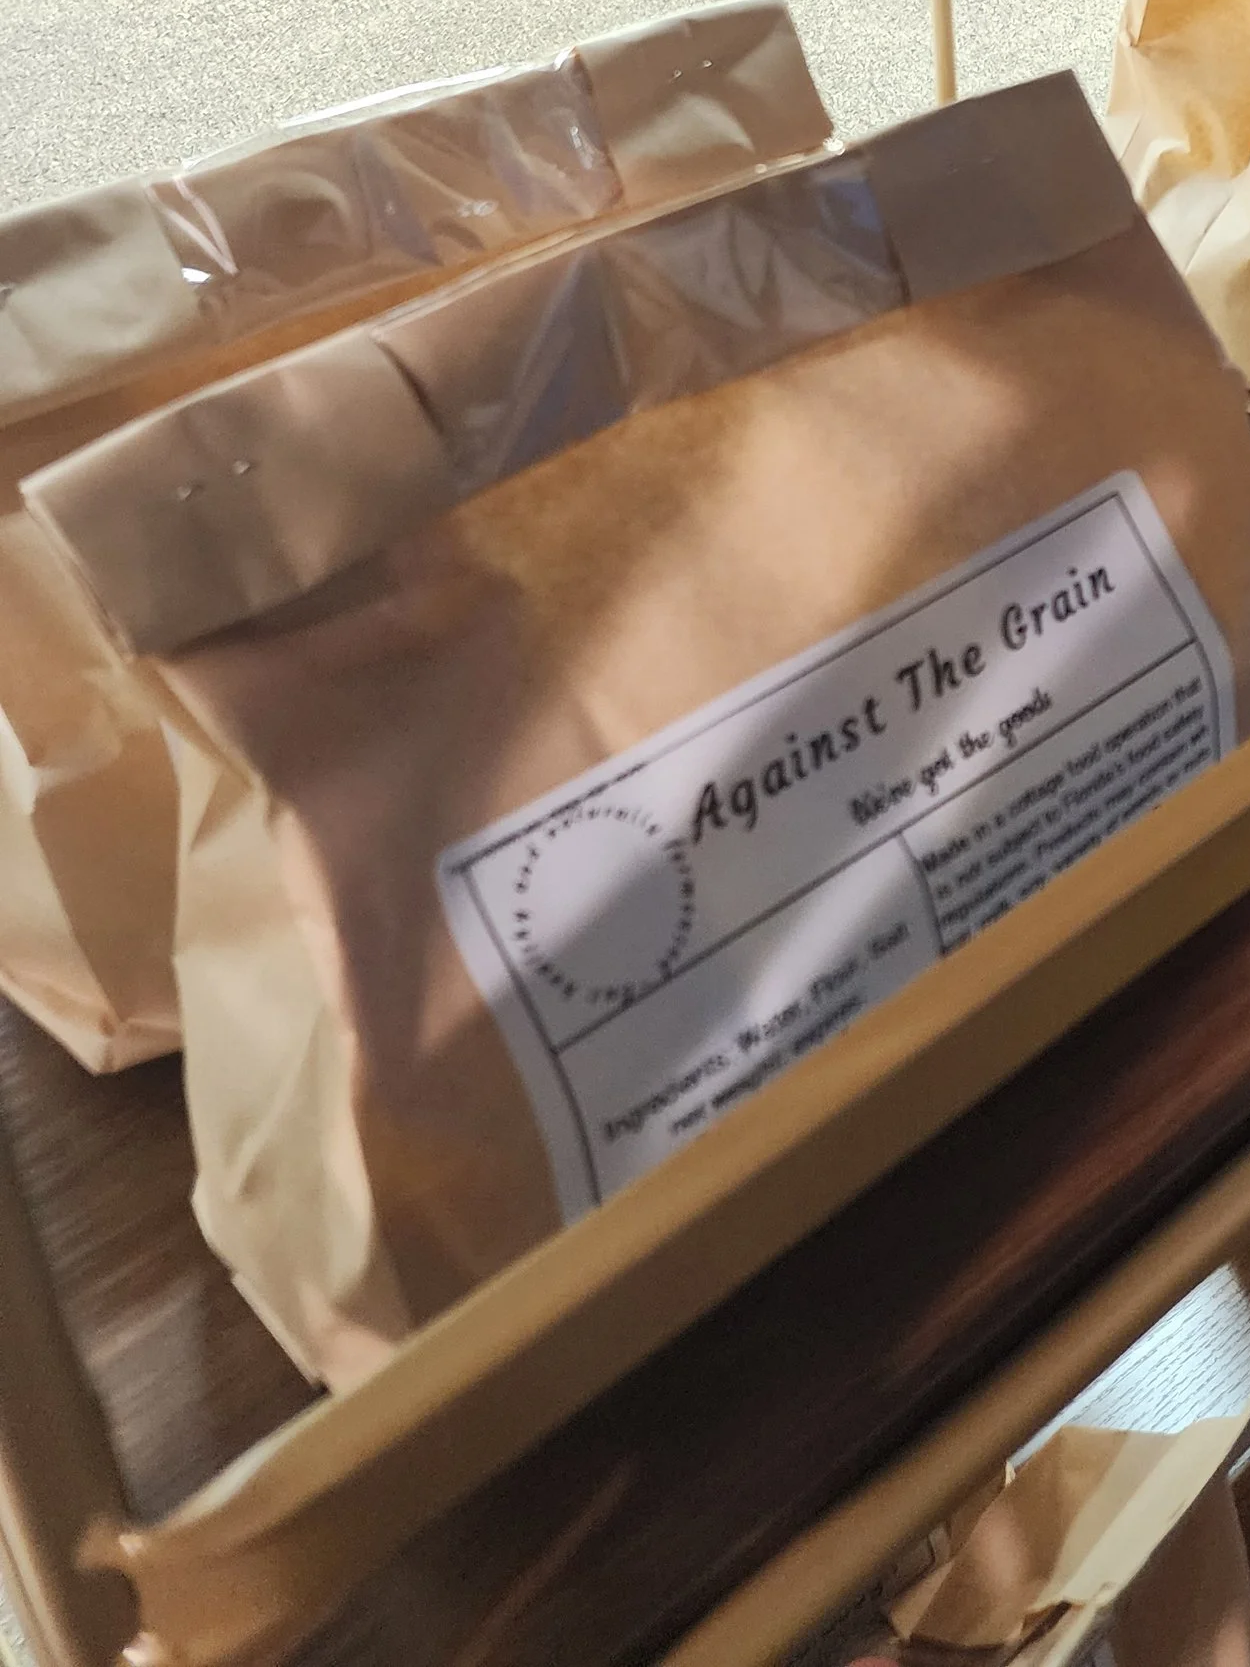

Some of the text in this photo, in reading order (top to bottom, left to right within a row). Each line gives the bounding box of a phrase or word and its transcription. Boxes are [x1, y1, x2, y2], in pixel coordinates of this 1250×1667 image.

[692, 564, 1116, 845] Against The Grain
[919, 749, 954, 796] got
[956, 730, 993, 761] the
[998, 687, 1053, 747] goods
